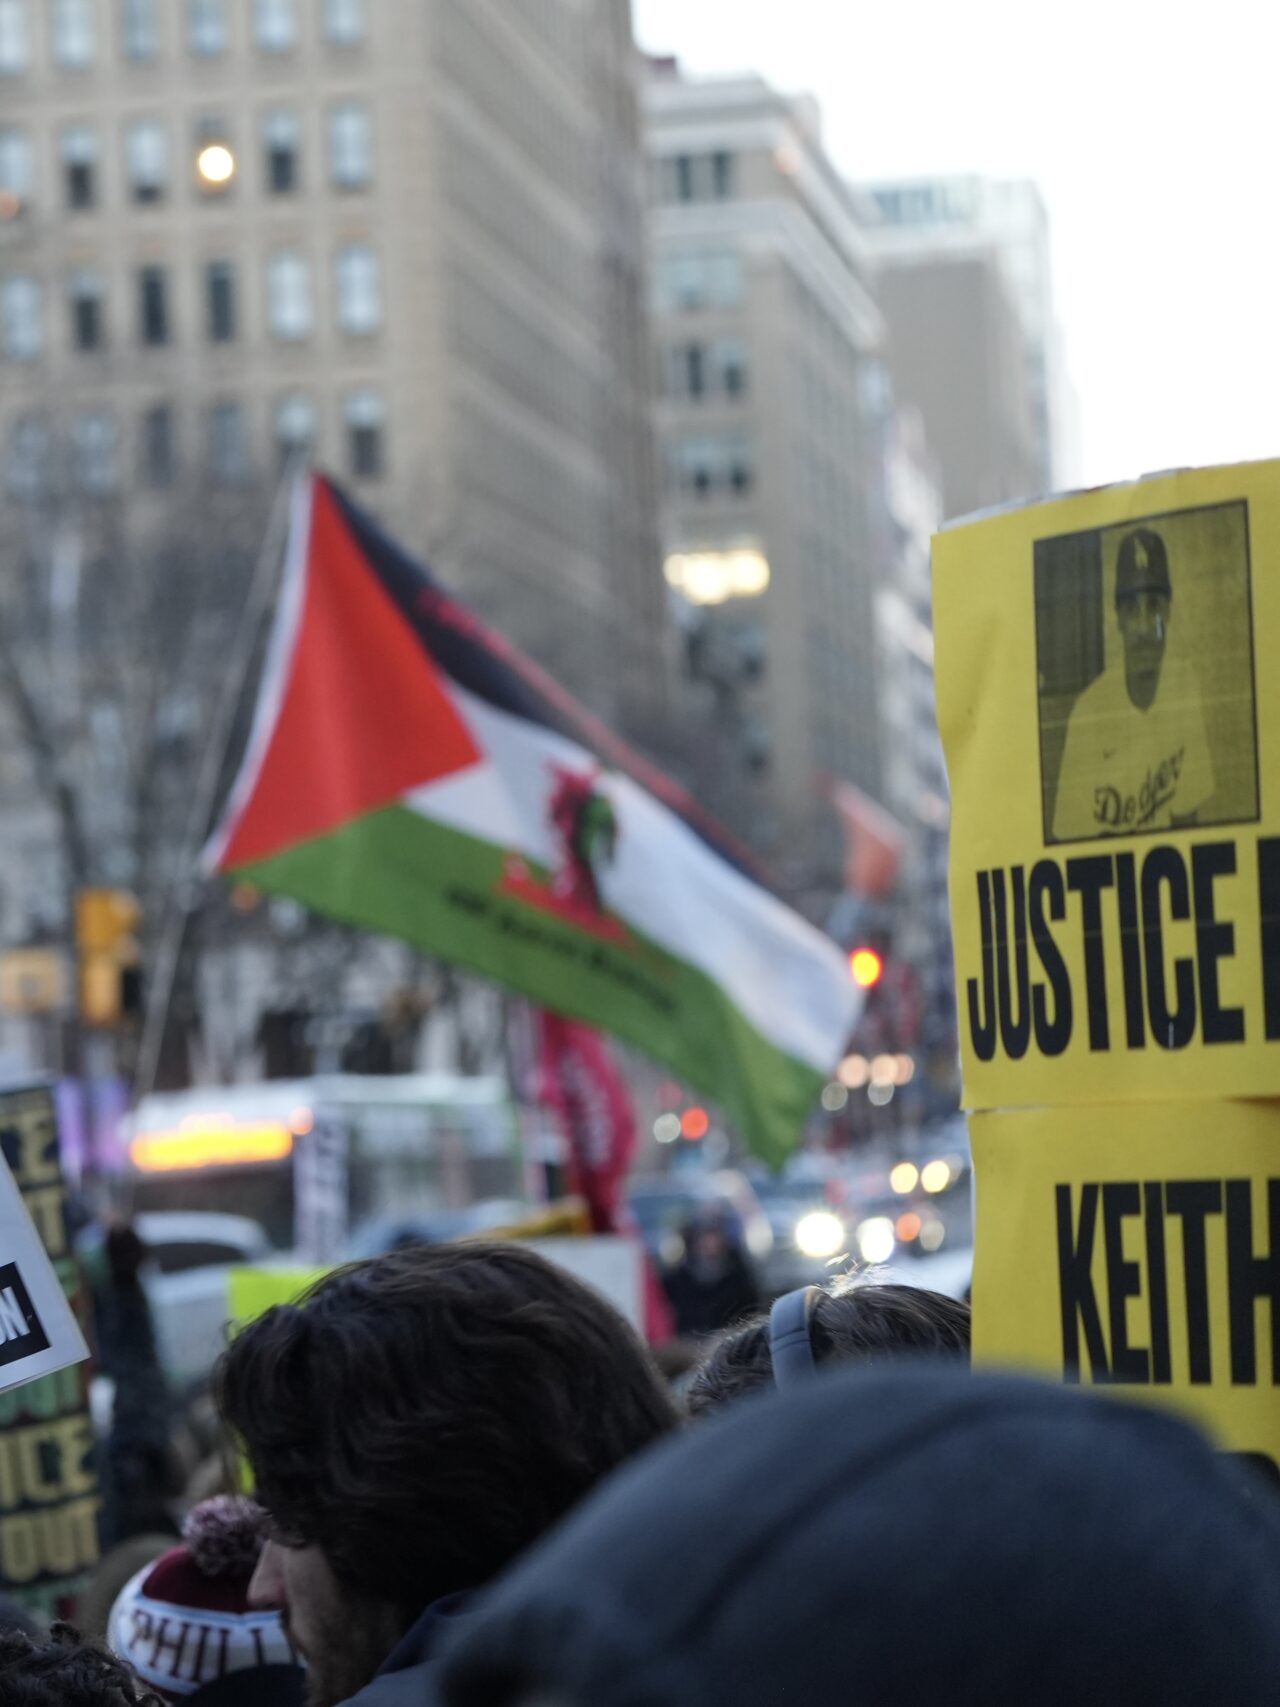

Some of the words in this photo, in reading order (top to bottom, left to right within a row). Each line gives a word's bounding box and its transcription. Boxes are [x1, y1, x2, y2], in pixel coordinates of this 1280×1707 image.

[967, 842, 1246, 1062] JUSTICE
[1055, 1178, 1280, 1385] KEITH
[0, 1500, 102, 1583] OUT
